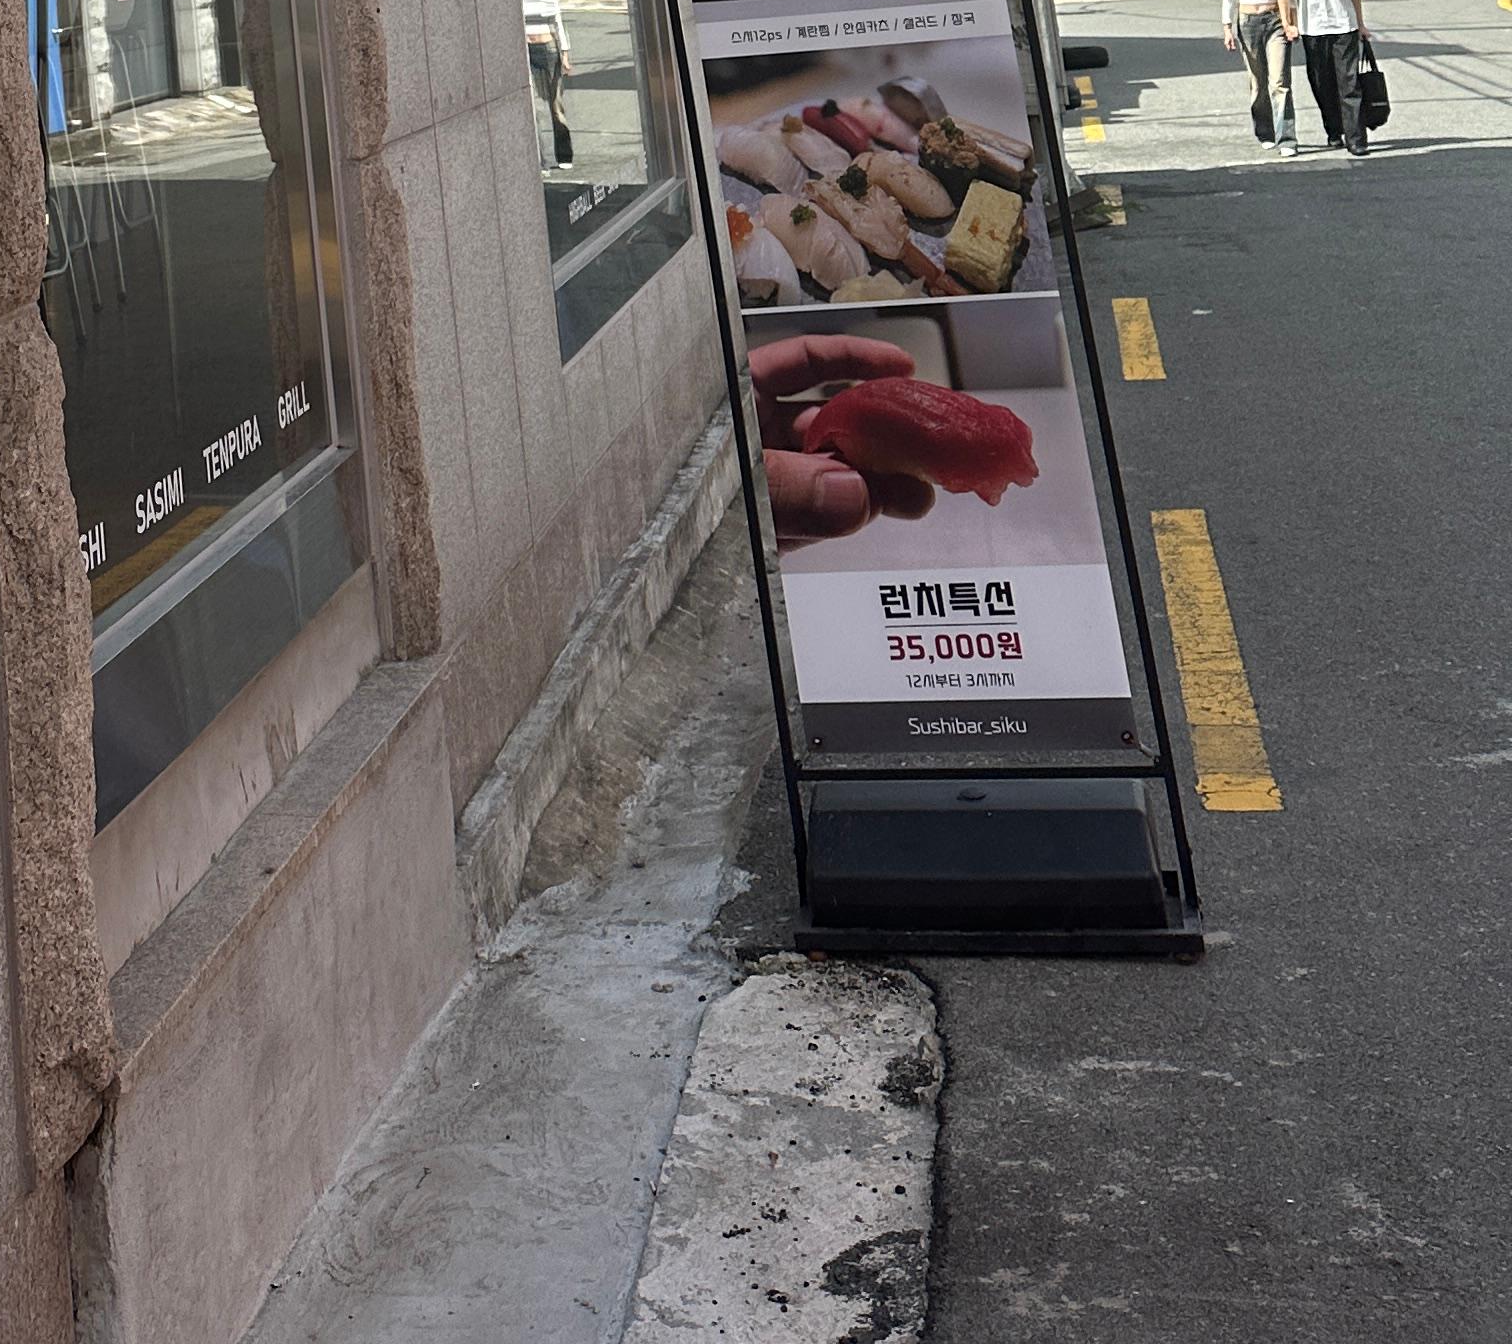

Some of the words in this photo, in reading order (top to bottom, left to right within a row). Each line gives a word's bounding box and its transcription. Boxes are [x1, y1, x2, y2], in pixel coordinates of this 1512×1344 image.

[135, 466, 185, 535] SASIMI
[202, 414, 262, 484] TENPURA
[277, 380, 311, 430] GRILL
[879, 580, 1018, 620] 런치특선
[887, 630, 1023, 665] 35,000원
[905, 673, 962, 688] 12시부터
[965, 672, 1016, 687] 3시까지
[907, 716, 1028, 737] Sushibar_siku
